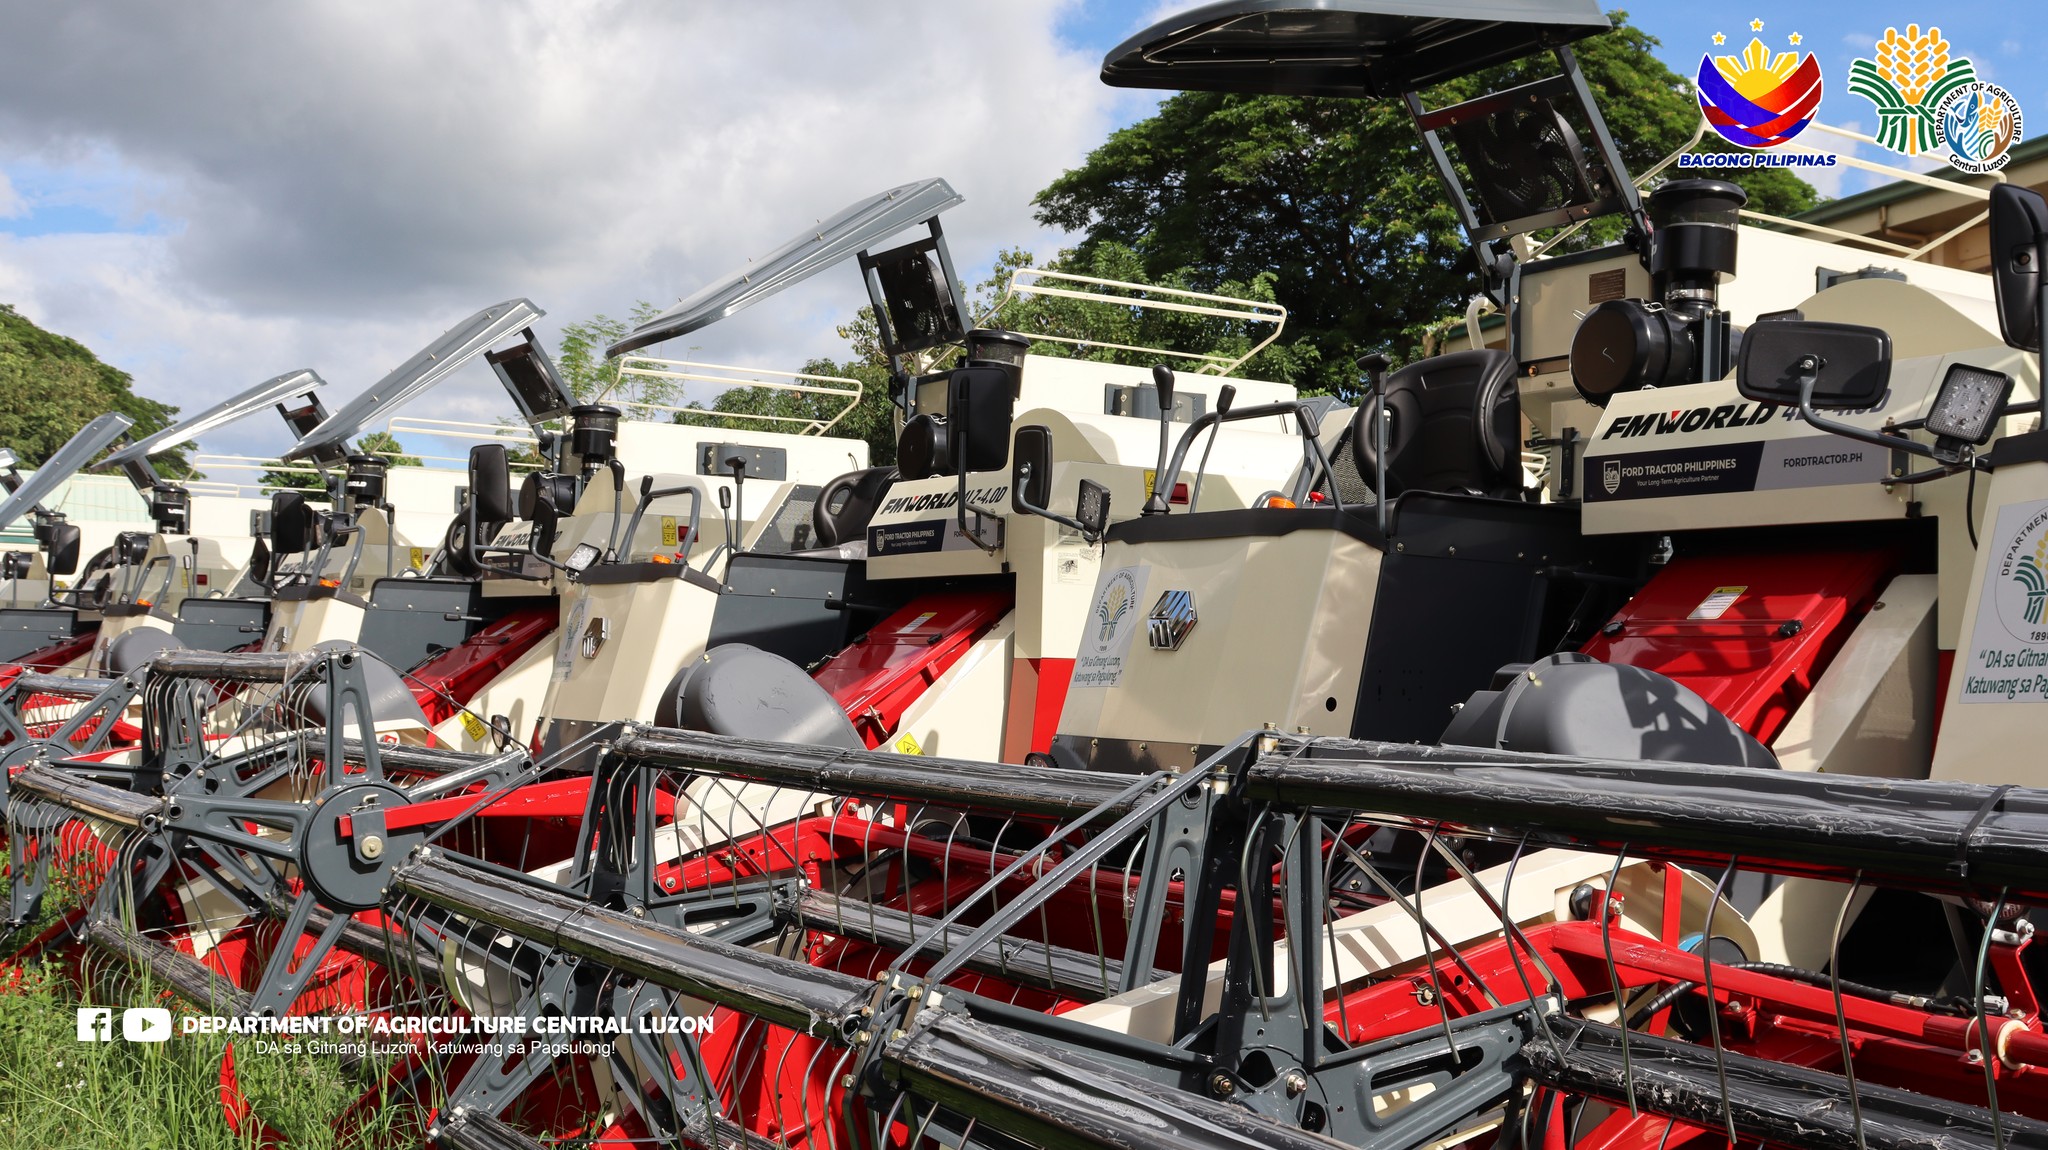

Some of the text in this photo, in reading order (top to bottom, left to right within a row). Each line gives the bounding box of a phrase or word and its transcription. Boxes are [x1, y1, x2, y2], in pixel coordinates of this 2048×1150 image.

[1601, 402, 1779, 440] FMWORLD
[1621, 458, 1737, 477] FORD TRACTOR PHILIPPINES
[1783, 453, 1863, 468] FORDTRACTOR.PH
[1674, 476, 1700, 485] Agriculture
[1701, 474, 1719, 482] Partner
[880, 491, 959, 515] FMWORLD
[2002, 653, 2015, 667] sa
[1965, 675, 2019, 699] Katuwang
[2019, 679, 2032, 693] sa
